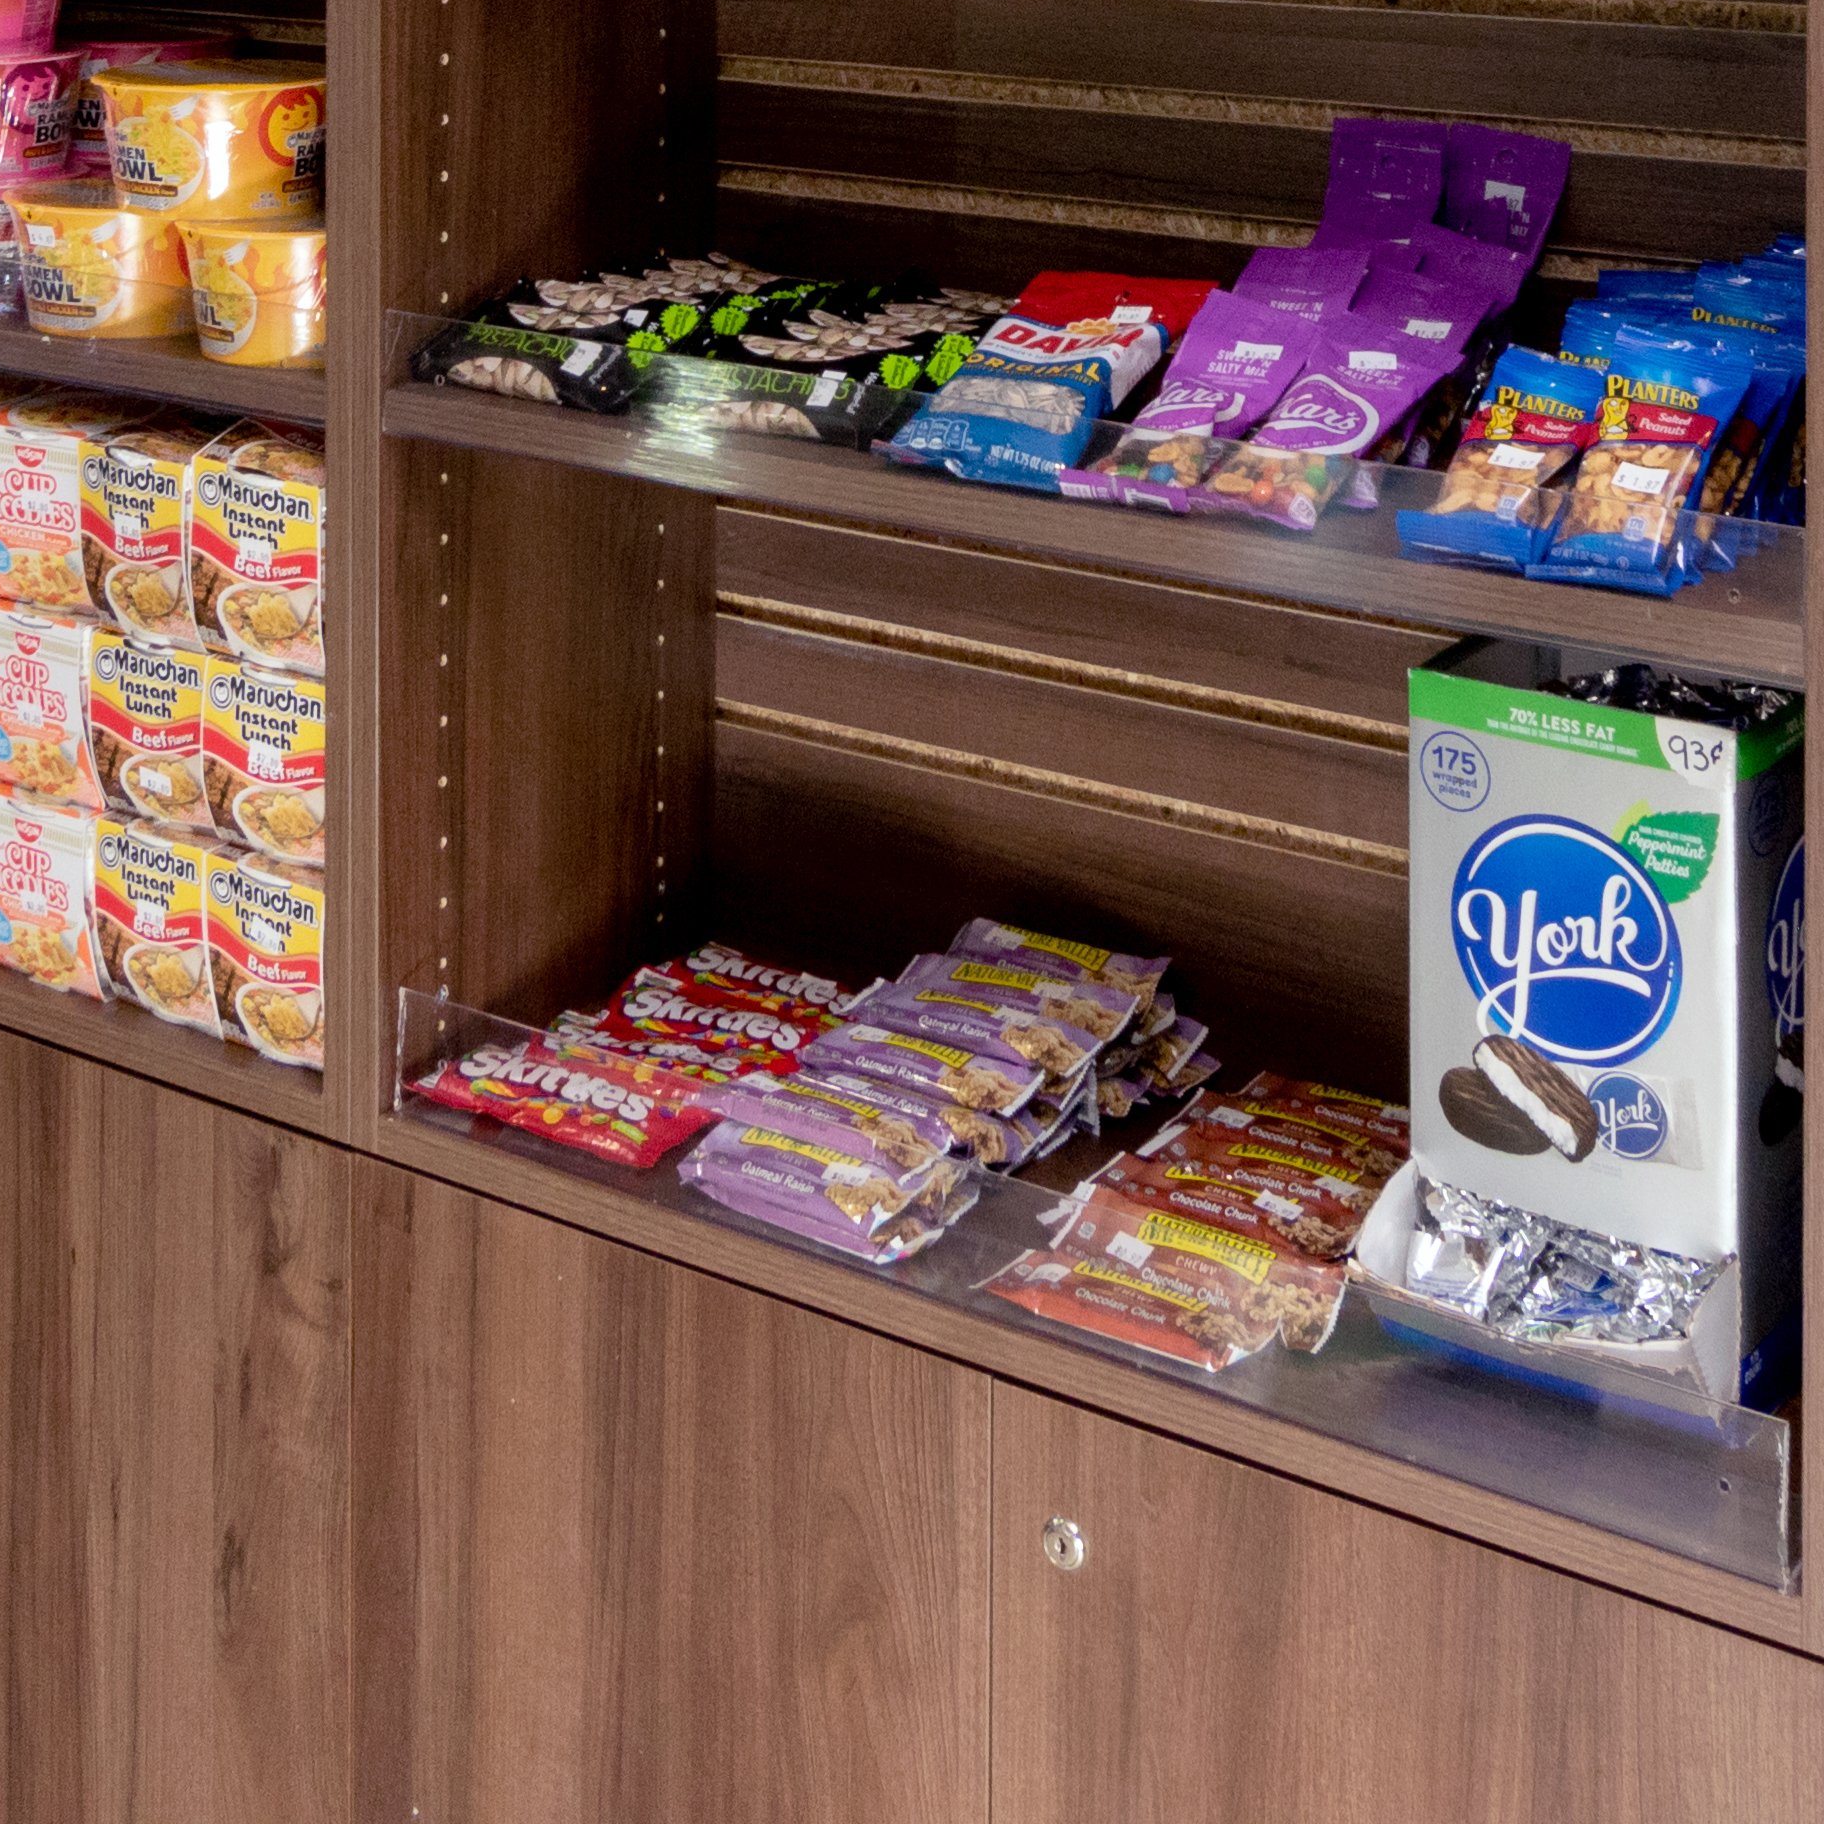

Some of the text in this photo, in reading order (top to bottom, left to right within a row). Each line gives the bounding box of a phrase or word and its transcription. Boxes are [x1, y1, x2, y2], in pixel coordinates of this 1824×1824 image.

[1207, 362, 1268, 378] SALTY MIX
[1498, 385, 1585, 422] PLANTERS
[1606, 373, 1699, 410] PLANTERS
[114, 648, 199, 686] Maruchan
[120, 678, 177, 702] Instant
[125, 698, 172, 720] Lunch
[1508, 708, 1538, 725] 70%
[1541, 713, 1580, 735] LESS
[1584, 721, 1616, 741] FAT
[133, 727, 194, 747] Beef Flavor
[1667, 735, 1722, 771] 93¢
[1433, 745, 1477, 774] 175
[1433, 769, 1478, 790] wrapped
[1438, 784, 1471, 798] pieces
[1628, 830, 1707, 861] Peppermint
[1644, 855, 1691, 878] Patties
[1458, 875, 1666, 1041] York
[622, 987, 802, 1050] Skittles
[459, 1048, 652, 1122] Skittles
[1594, 1097, 1654, 1150] York
[741, 1160, 814, 1197] Oatmeal Raisin
[1169, 1188, 1259, 1225] Chocolate Chunk
[1175, 1256, 1217, 1275] CHEWY
[1074, 1286, 1164, 1325] Chocolate Chunk
